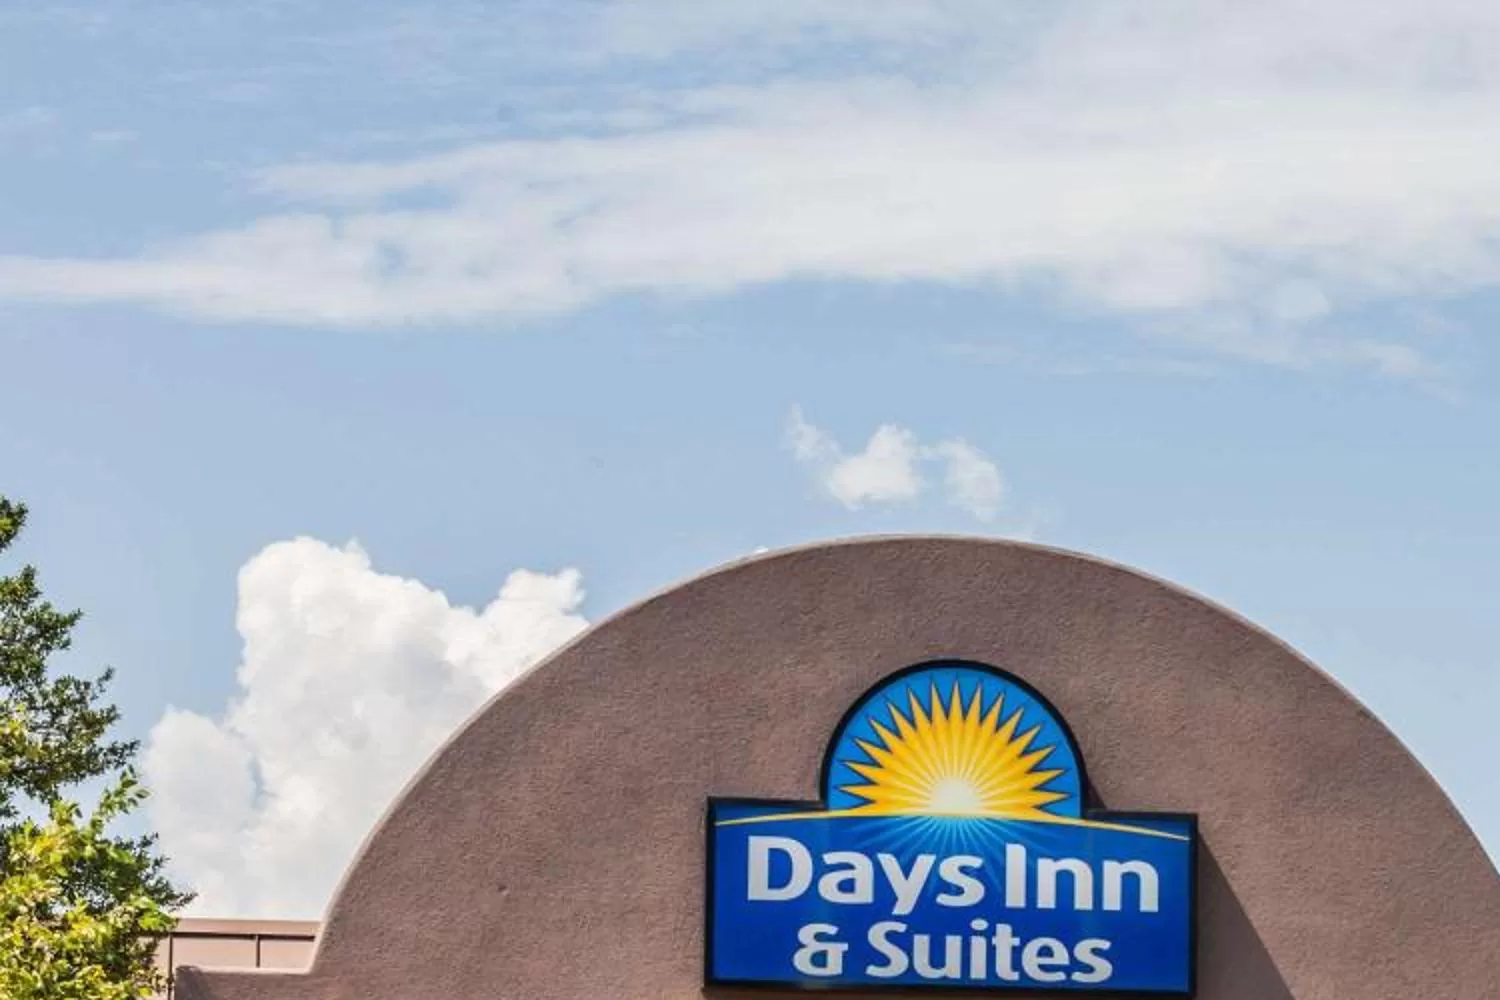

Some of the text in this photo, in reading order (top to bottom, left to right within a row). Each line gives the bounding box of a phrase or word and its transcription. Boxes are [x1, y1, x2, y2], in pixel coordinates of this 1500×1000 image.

[747, 835, 1159, 915] Days Inn
[793, 918, 1113, 983] & Suites
